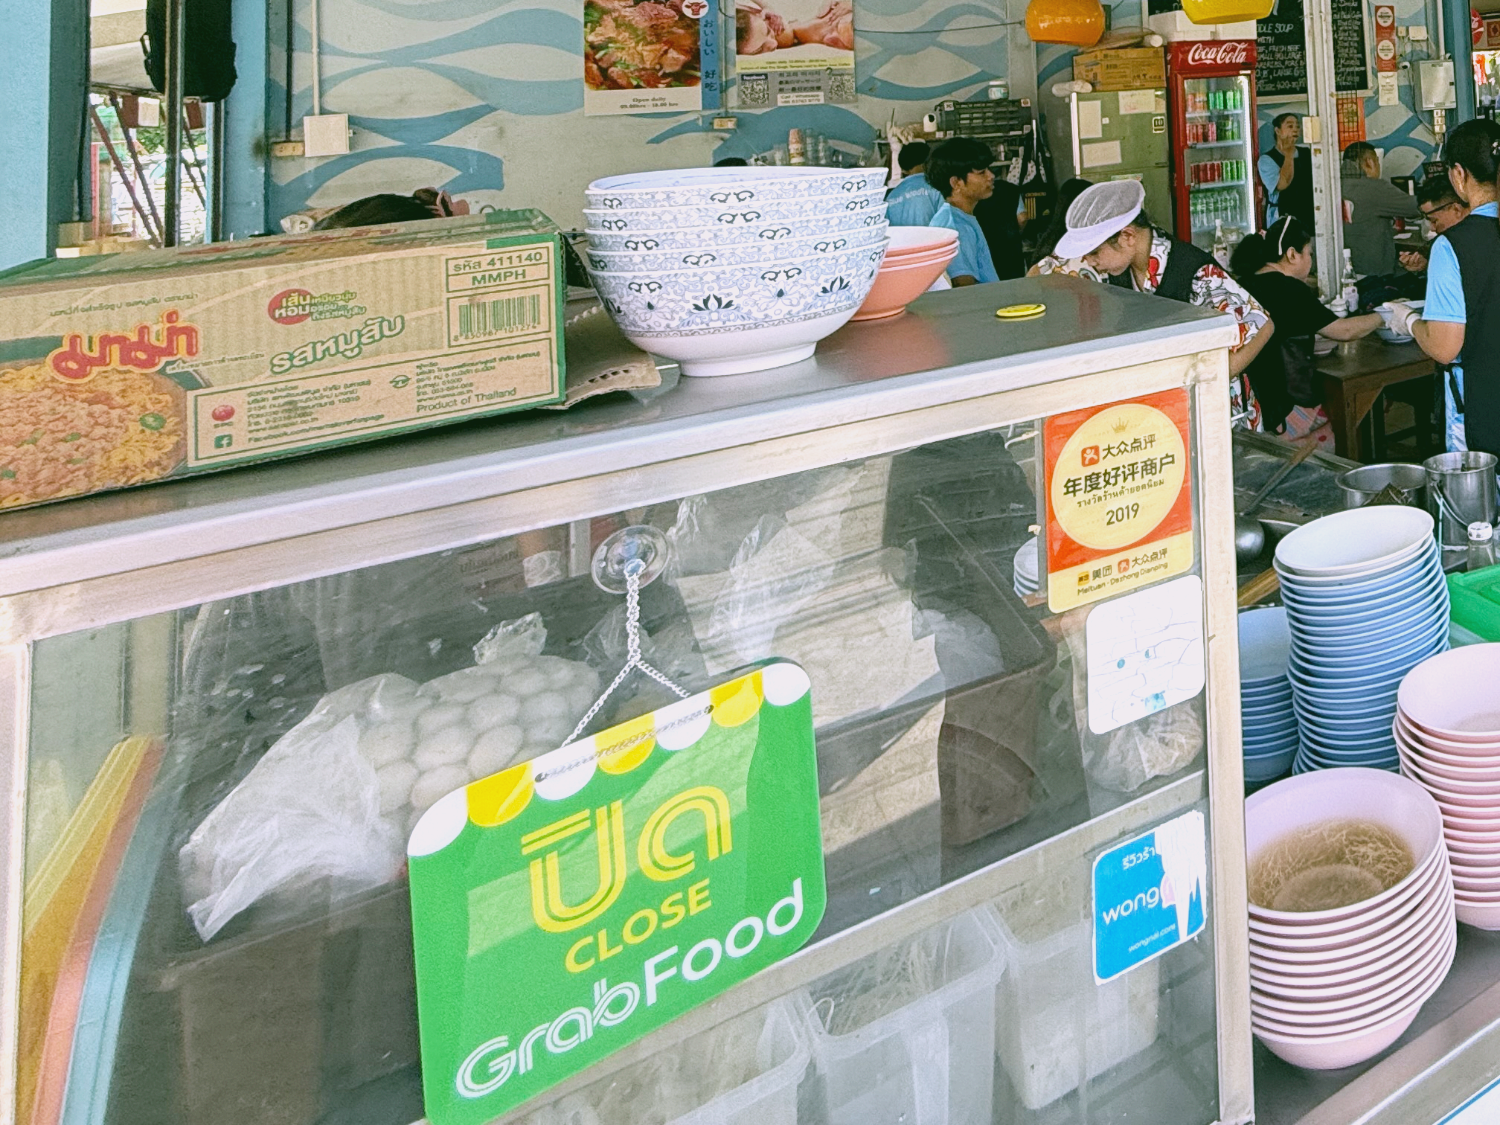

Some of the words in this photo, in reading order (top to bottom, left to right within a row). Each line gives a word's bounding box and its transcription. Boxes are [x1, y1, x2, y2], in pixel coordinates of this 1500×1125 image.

[703, 19, 715, 56] おいしい
[704, 68, 717, 92] 好吃
[453, 259, 482, 273] รหัส
[486, 251, 543, 267] 411140
[471, 268, 527, 286] MMPH
[270, 315, 405, 374] รสหมูสับ
[416, 397, 458, 413] Product
[460, 395, 472, 405] of
[474, 387, 517, 403] Thailand
[1102, 433, 1157, 461] 大众点评
[1062, 452, 1176, 498] 年度好评商户
[1105, 501, 1141, 527] 2019
[1131, 547, 1168, 569] 大众点评
[1077, 581, 1106, 596] Meituan
[1109, 571, 1140, 586] Dazhong
[1140, 562, 1169, 576] Dianping
[521, 786, 734, 934] ปิด
[1122, 845, 1156, 871] รีวิวร้า
[1102, 886, 1160, 926] wong
[564, 877, 713, 974] CLOSE
[455, 876, 805, 1099] GrabFood
